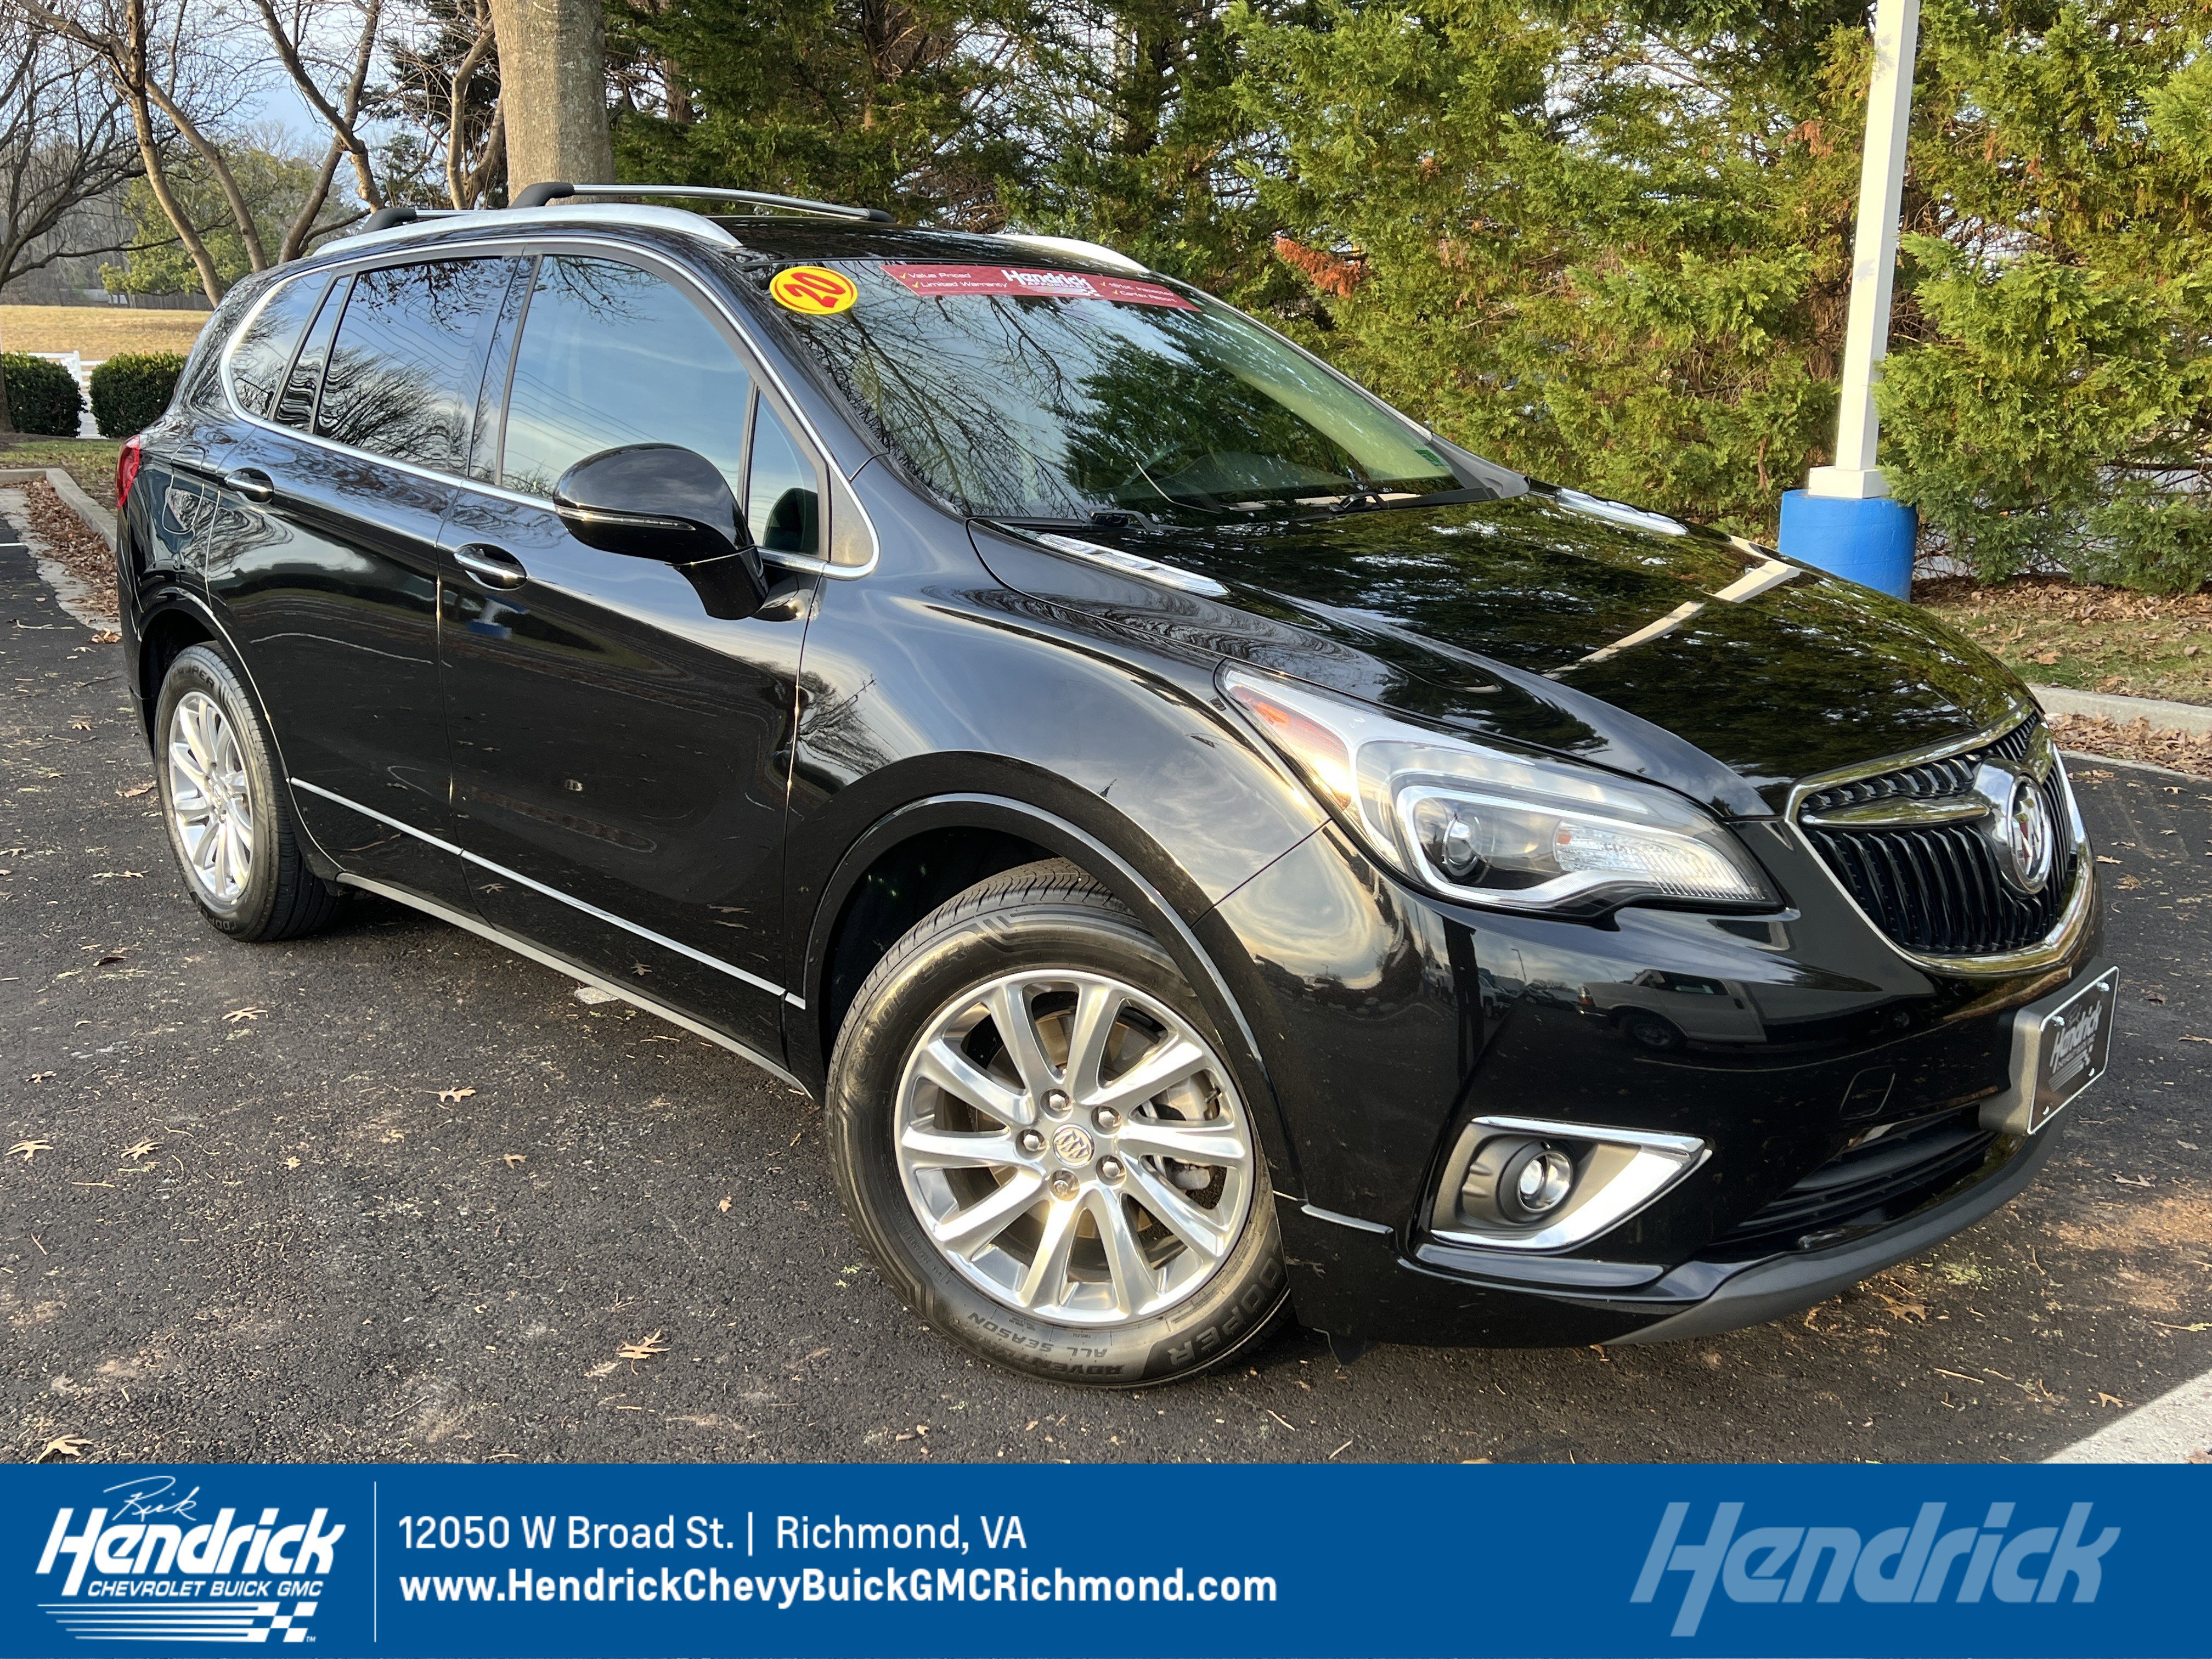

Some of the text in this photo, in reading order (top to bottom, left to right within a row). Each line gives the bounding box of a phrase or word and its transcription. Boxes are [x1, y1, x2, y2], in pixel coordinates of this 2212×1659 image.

[783, 272, 847, 308] 20
[1001, 269, 1092, 286] Hendrick
[2049, 1000, 2103, 1075] Hendrick
[1166, 1234, 1283, 1366] OOPER
[967, 1311, 1054, 1352] SEASON
[1066, 1346, 1108, 1358] ALL
